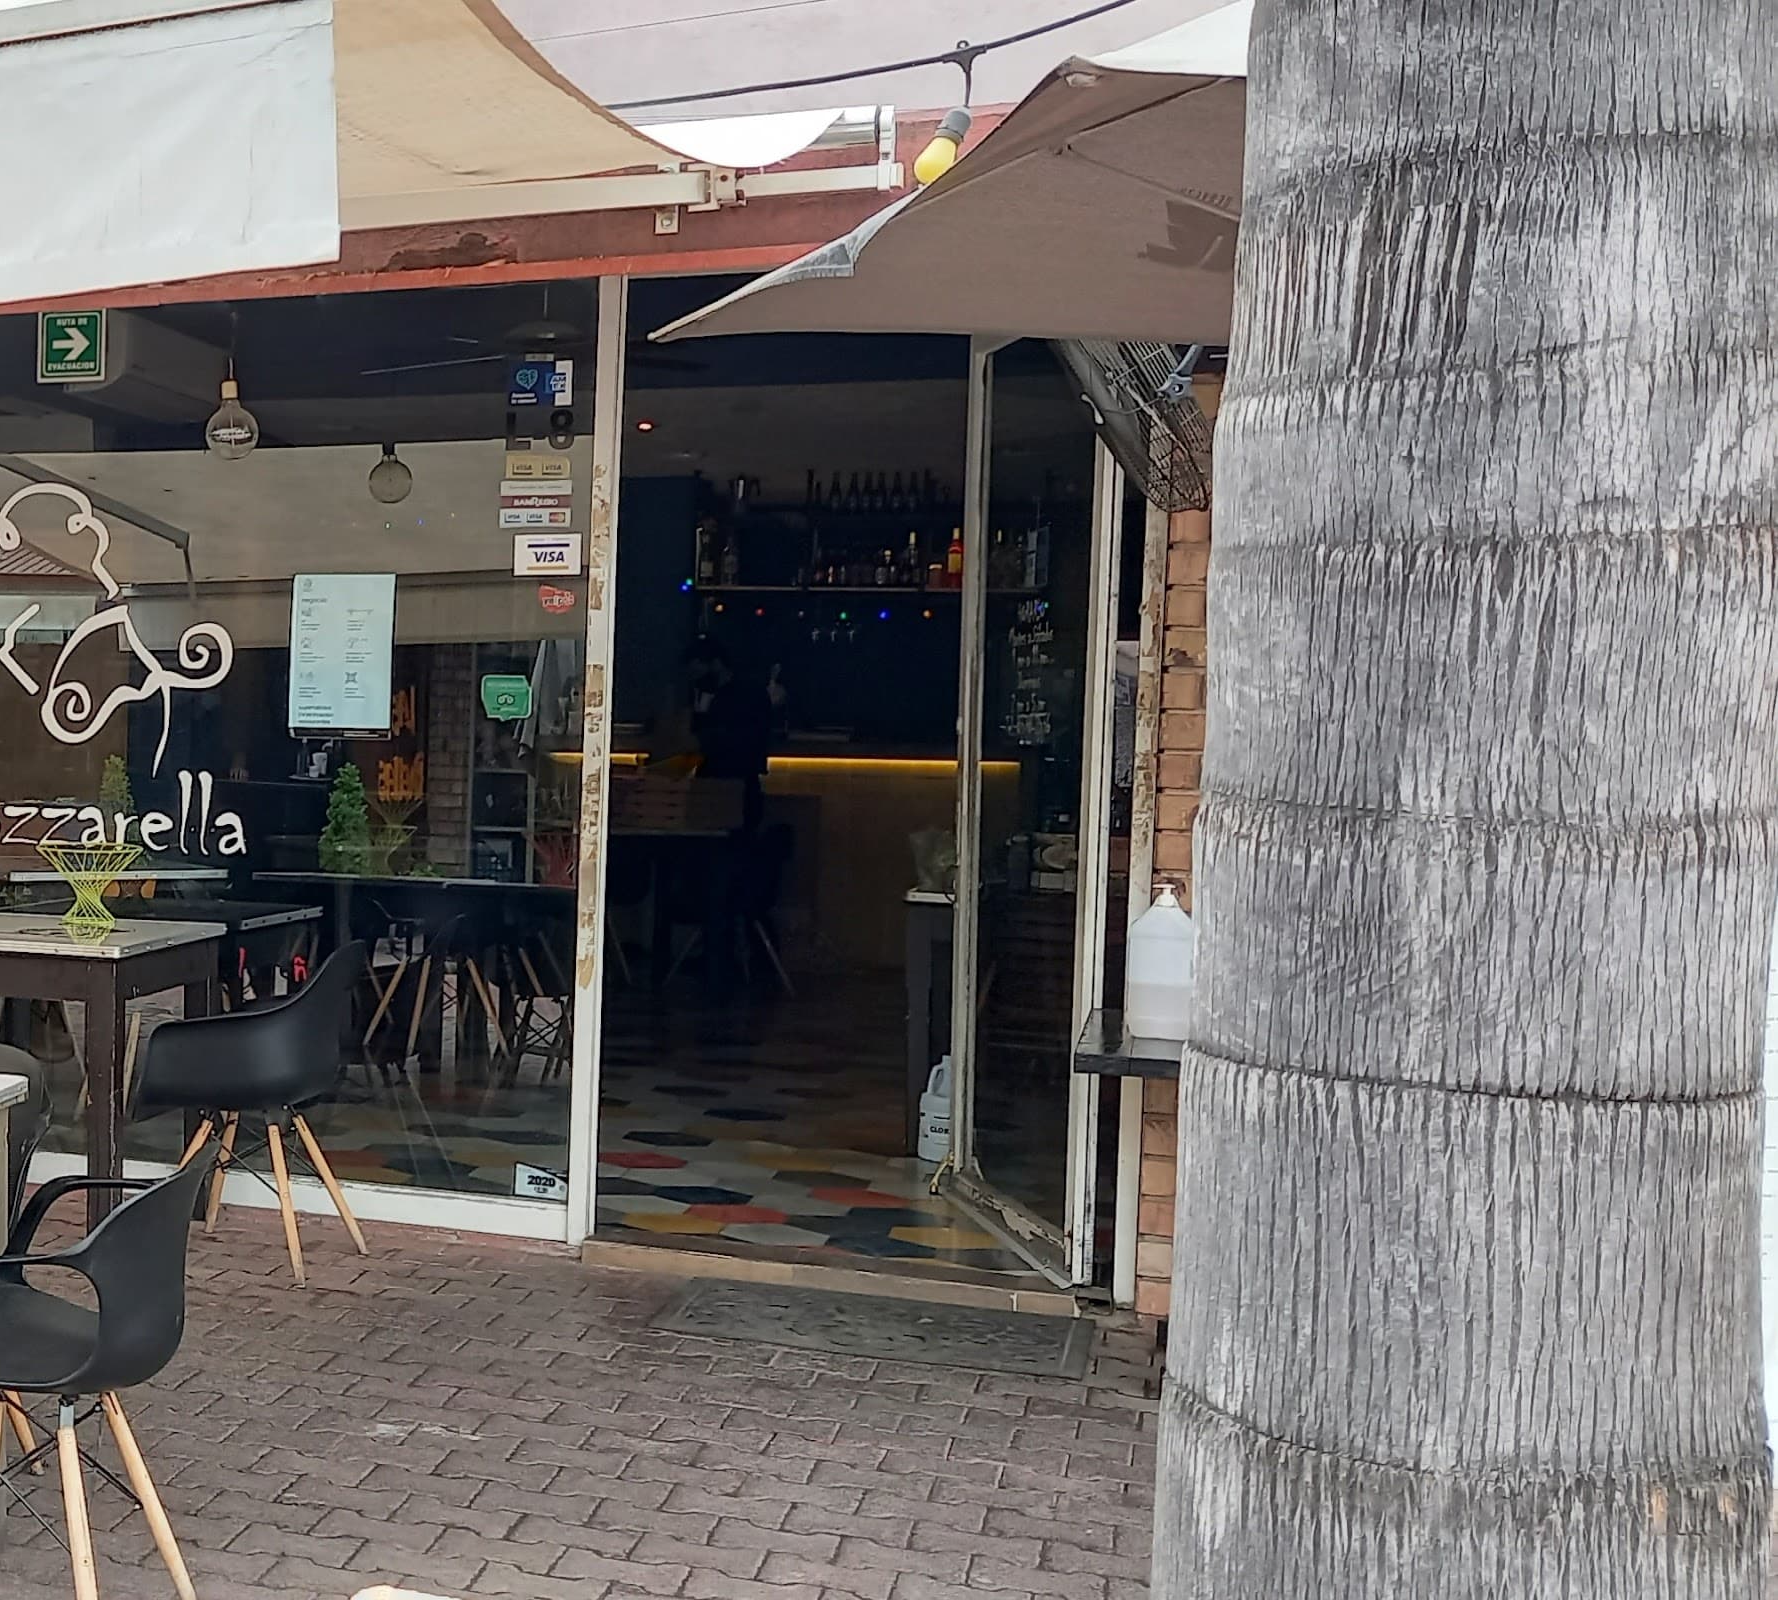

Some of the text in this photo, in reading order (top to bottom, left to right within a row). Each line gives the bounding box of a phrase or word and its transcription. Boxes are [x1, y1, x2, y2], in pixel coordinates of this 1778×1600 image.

[56, 318, 76, 326] RUTA
[534, 551, 565, 563] VISA
[527, 1175, 556, 1187] 2020
